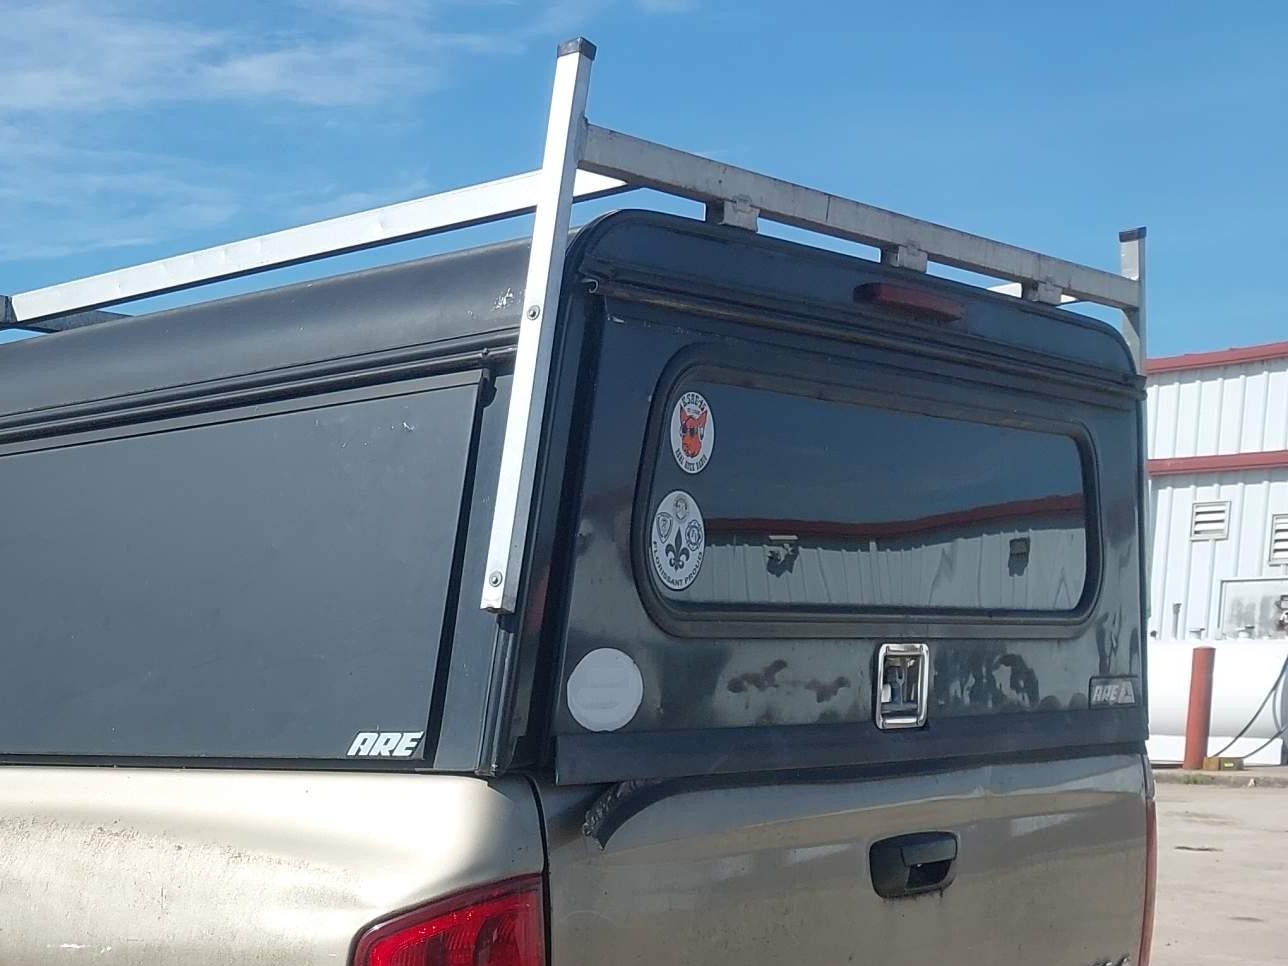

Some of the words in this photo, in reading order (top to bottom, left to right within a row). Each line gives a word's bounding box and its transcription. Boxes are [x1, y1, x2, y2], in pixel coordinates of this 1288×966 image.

[653, 540, 684, 586] FLORISSANT
[684, 551, 702, 584] PROUD
[346, 731, 424, 757] ARE
